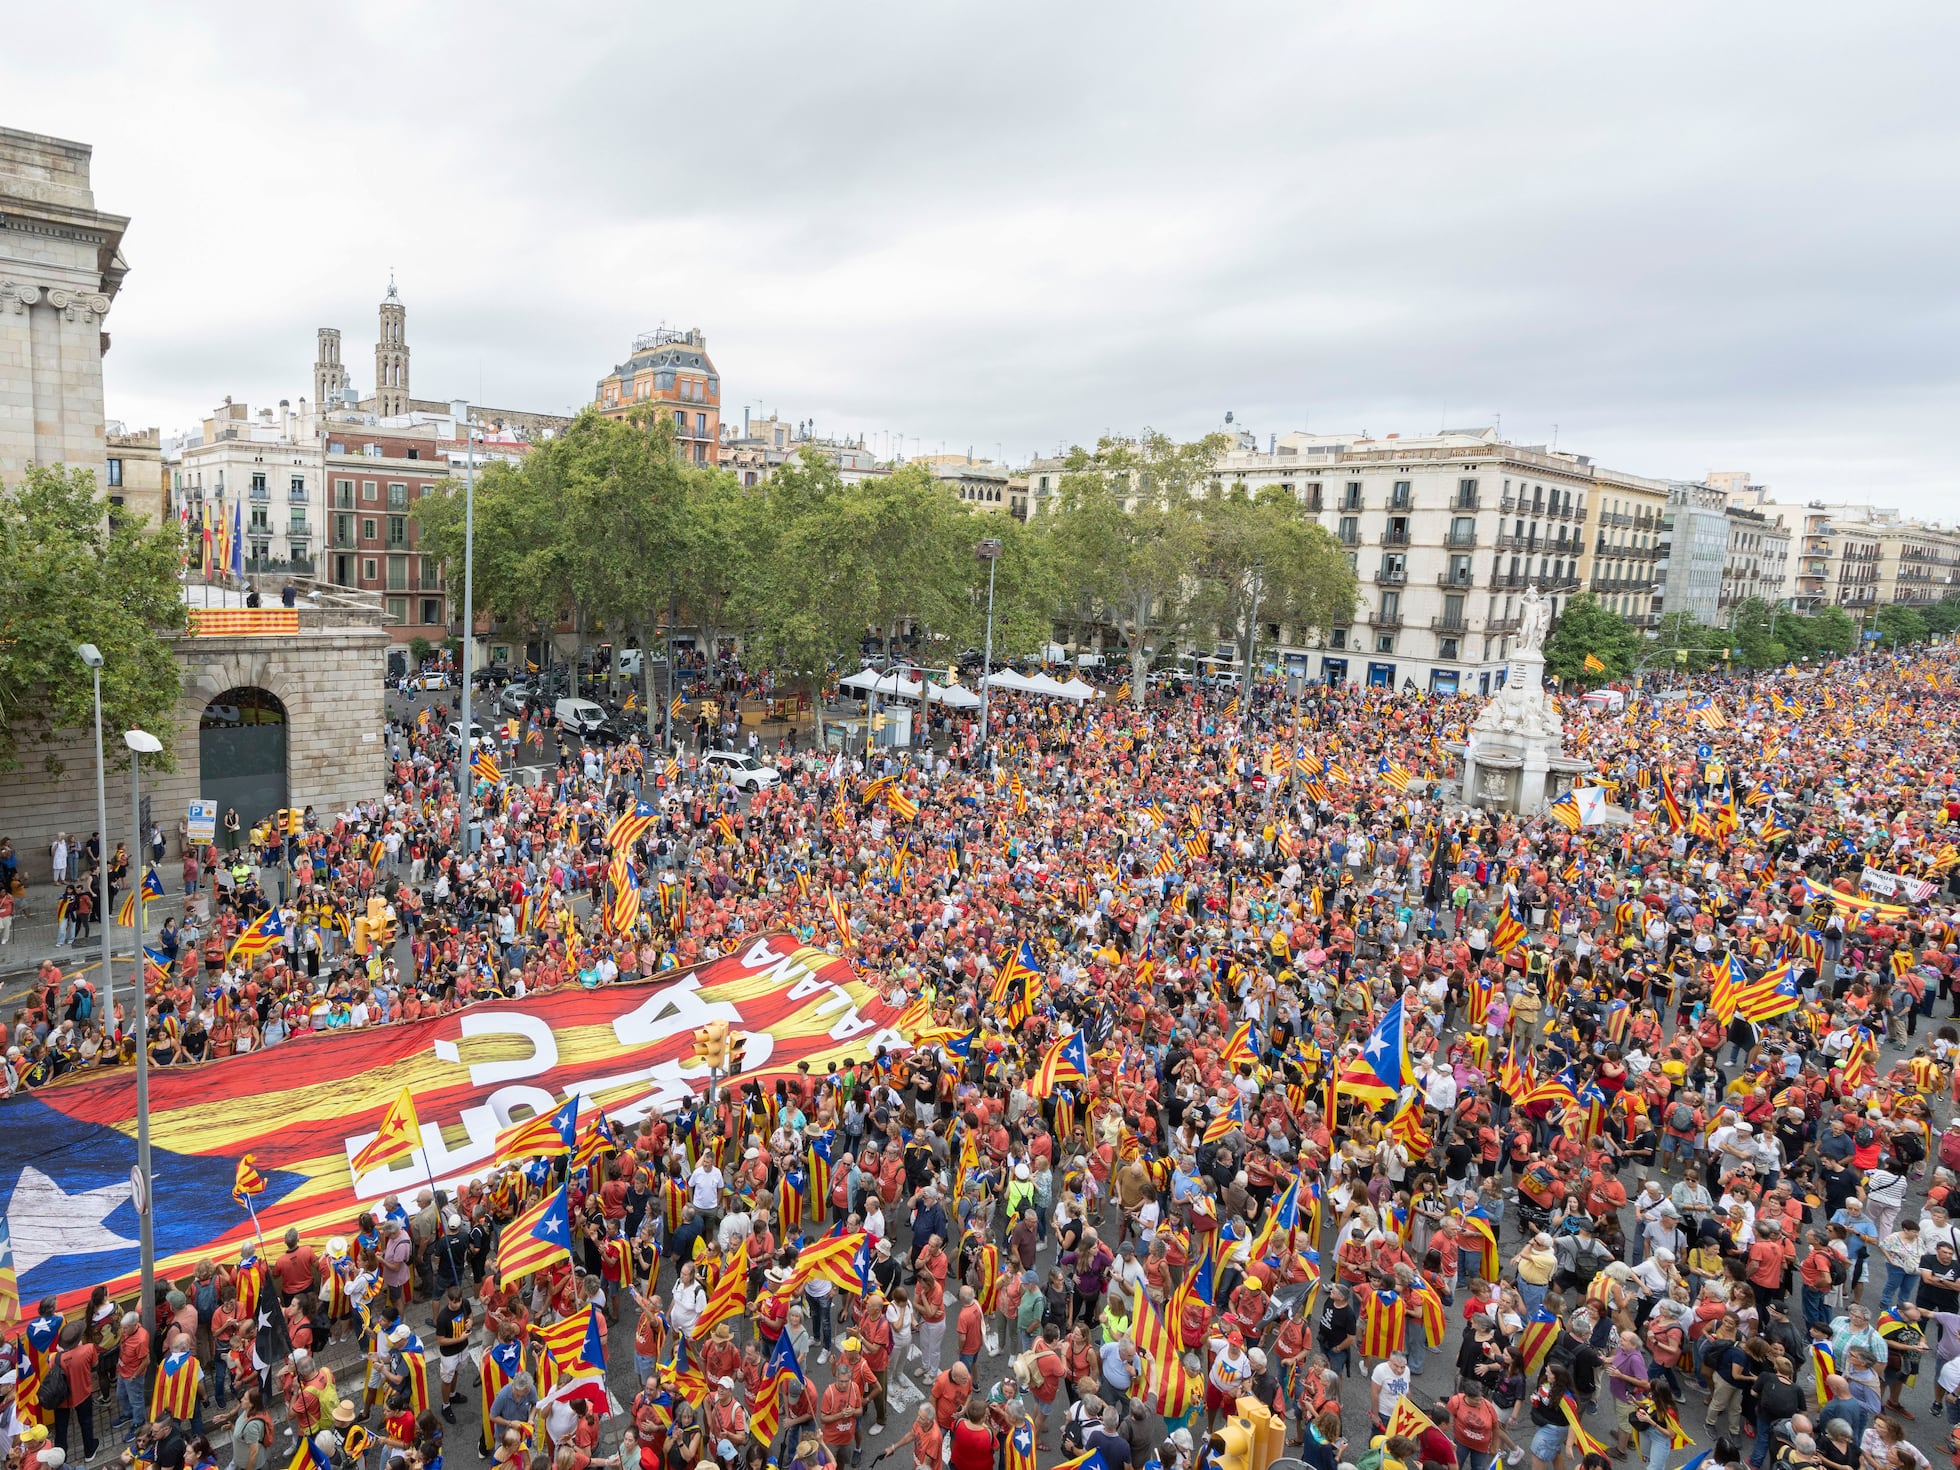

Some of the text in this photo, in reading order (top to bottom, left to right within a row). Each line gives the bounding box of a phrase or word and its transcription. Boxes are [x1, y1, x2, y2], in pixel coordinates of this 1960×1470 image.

[191, 806, 200, 816] P
[741, 938, 917, 1056] AALANA
[345, 1012, 590, 1222] EPÚ
